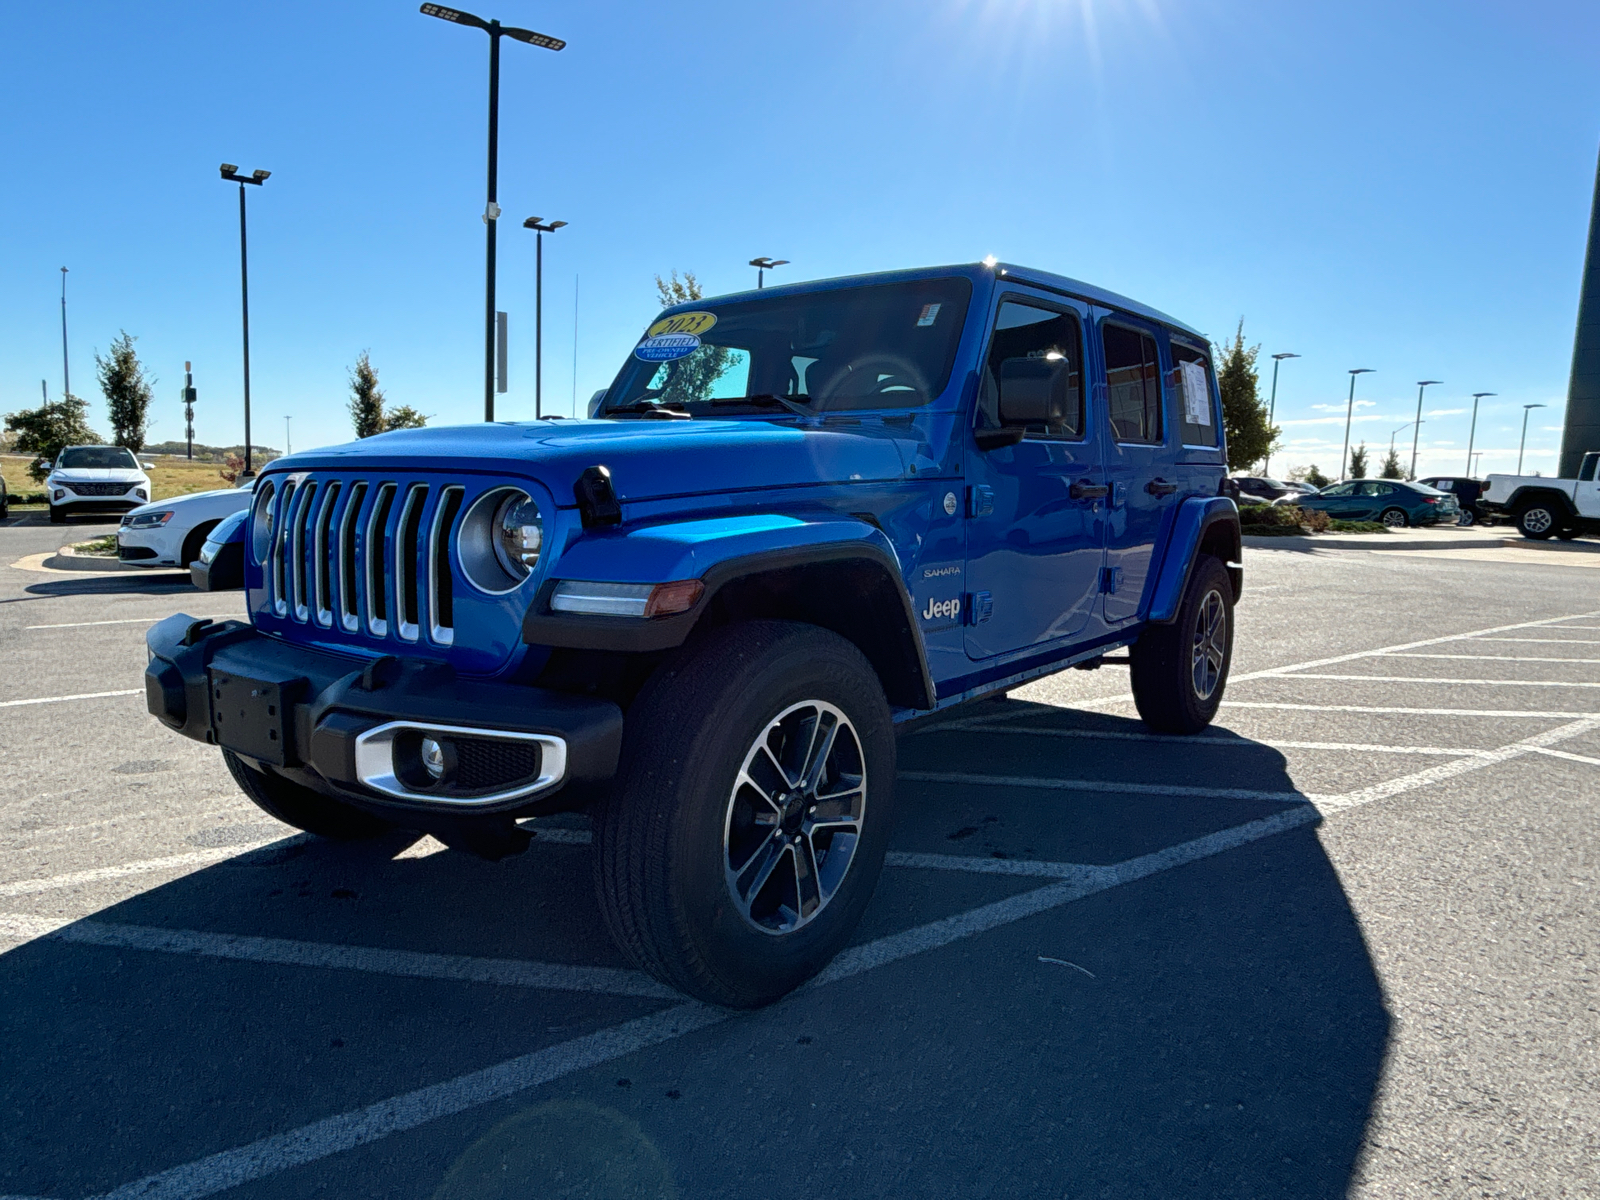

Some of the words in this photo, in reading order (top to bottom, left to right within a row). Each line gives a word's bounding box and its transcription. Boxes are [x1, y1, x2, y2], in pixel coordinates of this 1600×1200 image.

[655, 315, 707, 336] 2023
[644, 338, 695, 347] CERTIFIED
[924, 567, 961, 578] SAHARA
[923, 597, 960, 620] Jeep
